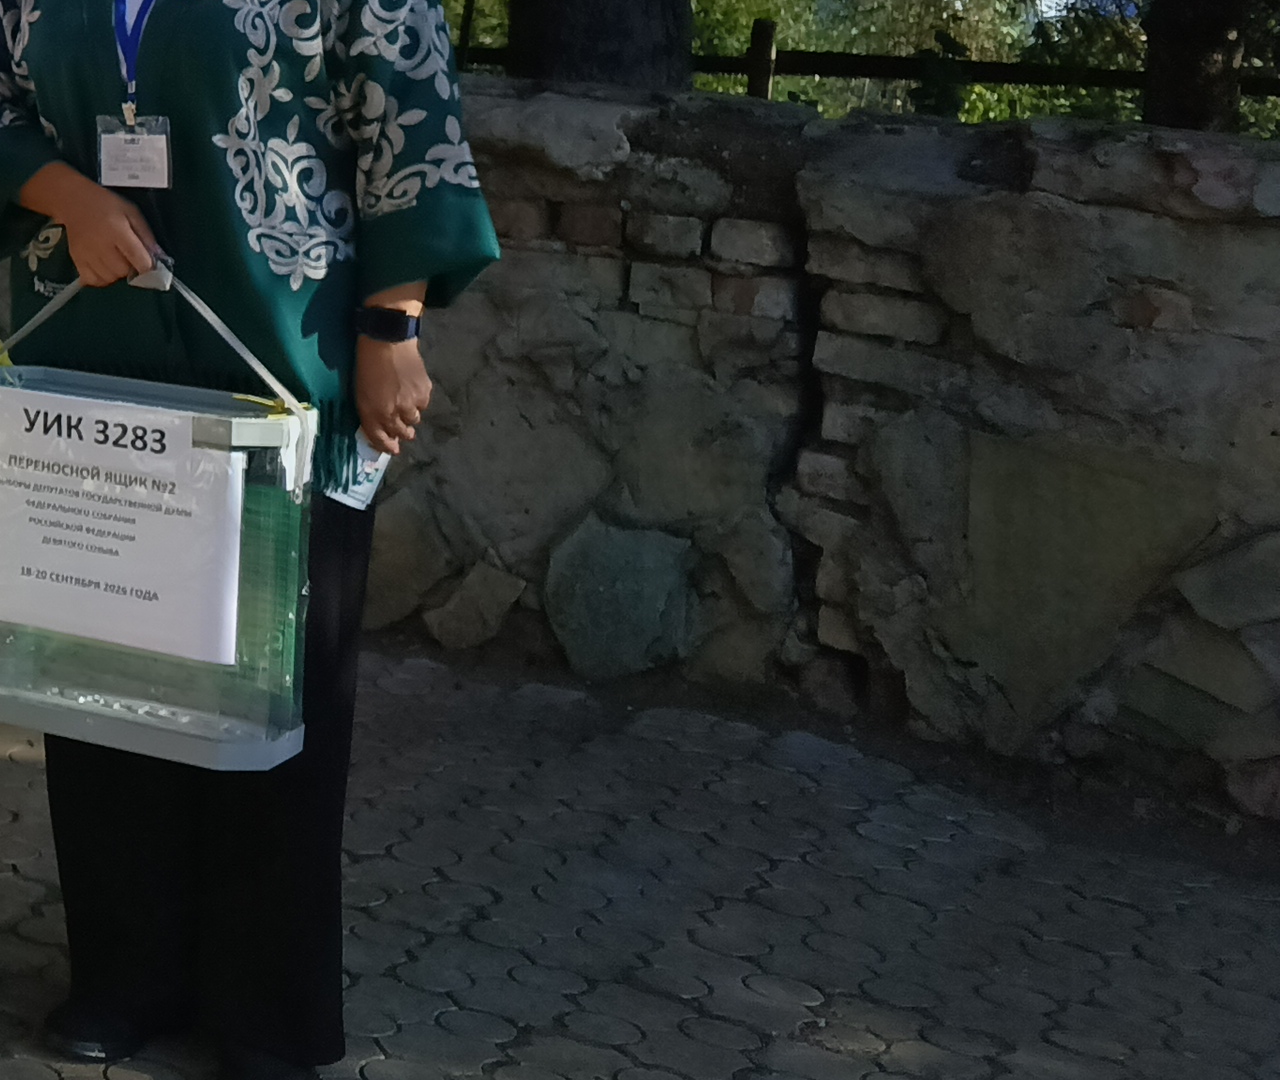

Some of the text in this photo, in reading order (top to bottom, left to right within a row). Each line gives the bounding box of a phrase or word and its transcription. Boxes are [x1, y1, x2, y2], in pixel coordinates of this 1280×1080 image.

[23, 407, 168, 454] УИК 3283
[8, 454, 176, 495] ПЕРЕНОСНОЙ ЯЩИК №2
[49, 572, 101, 590] СЕНТЯБРЯ
[130, 586, 159, 601] ГОДА
